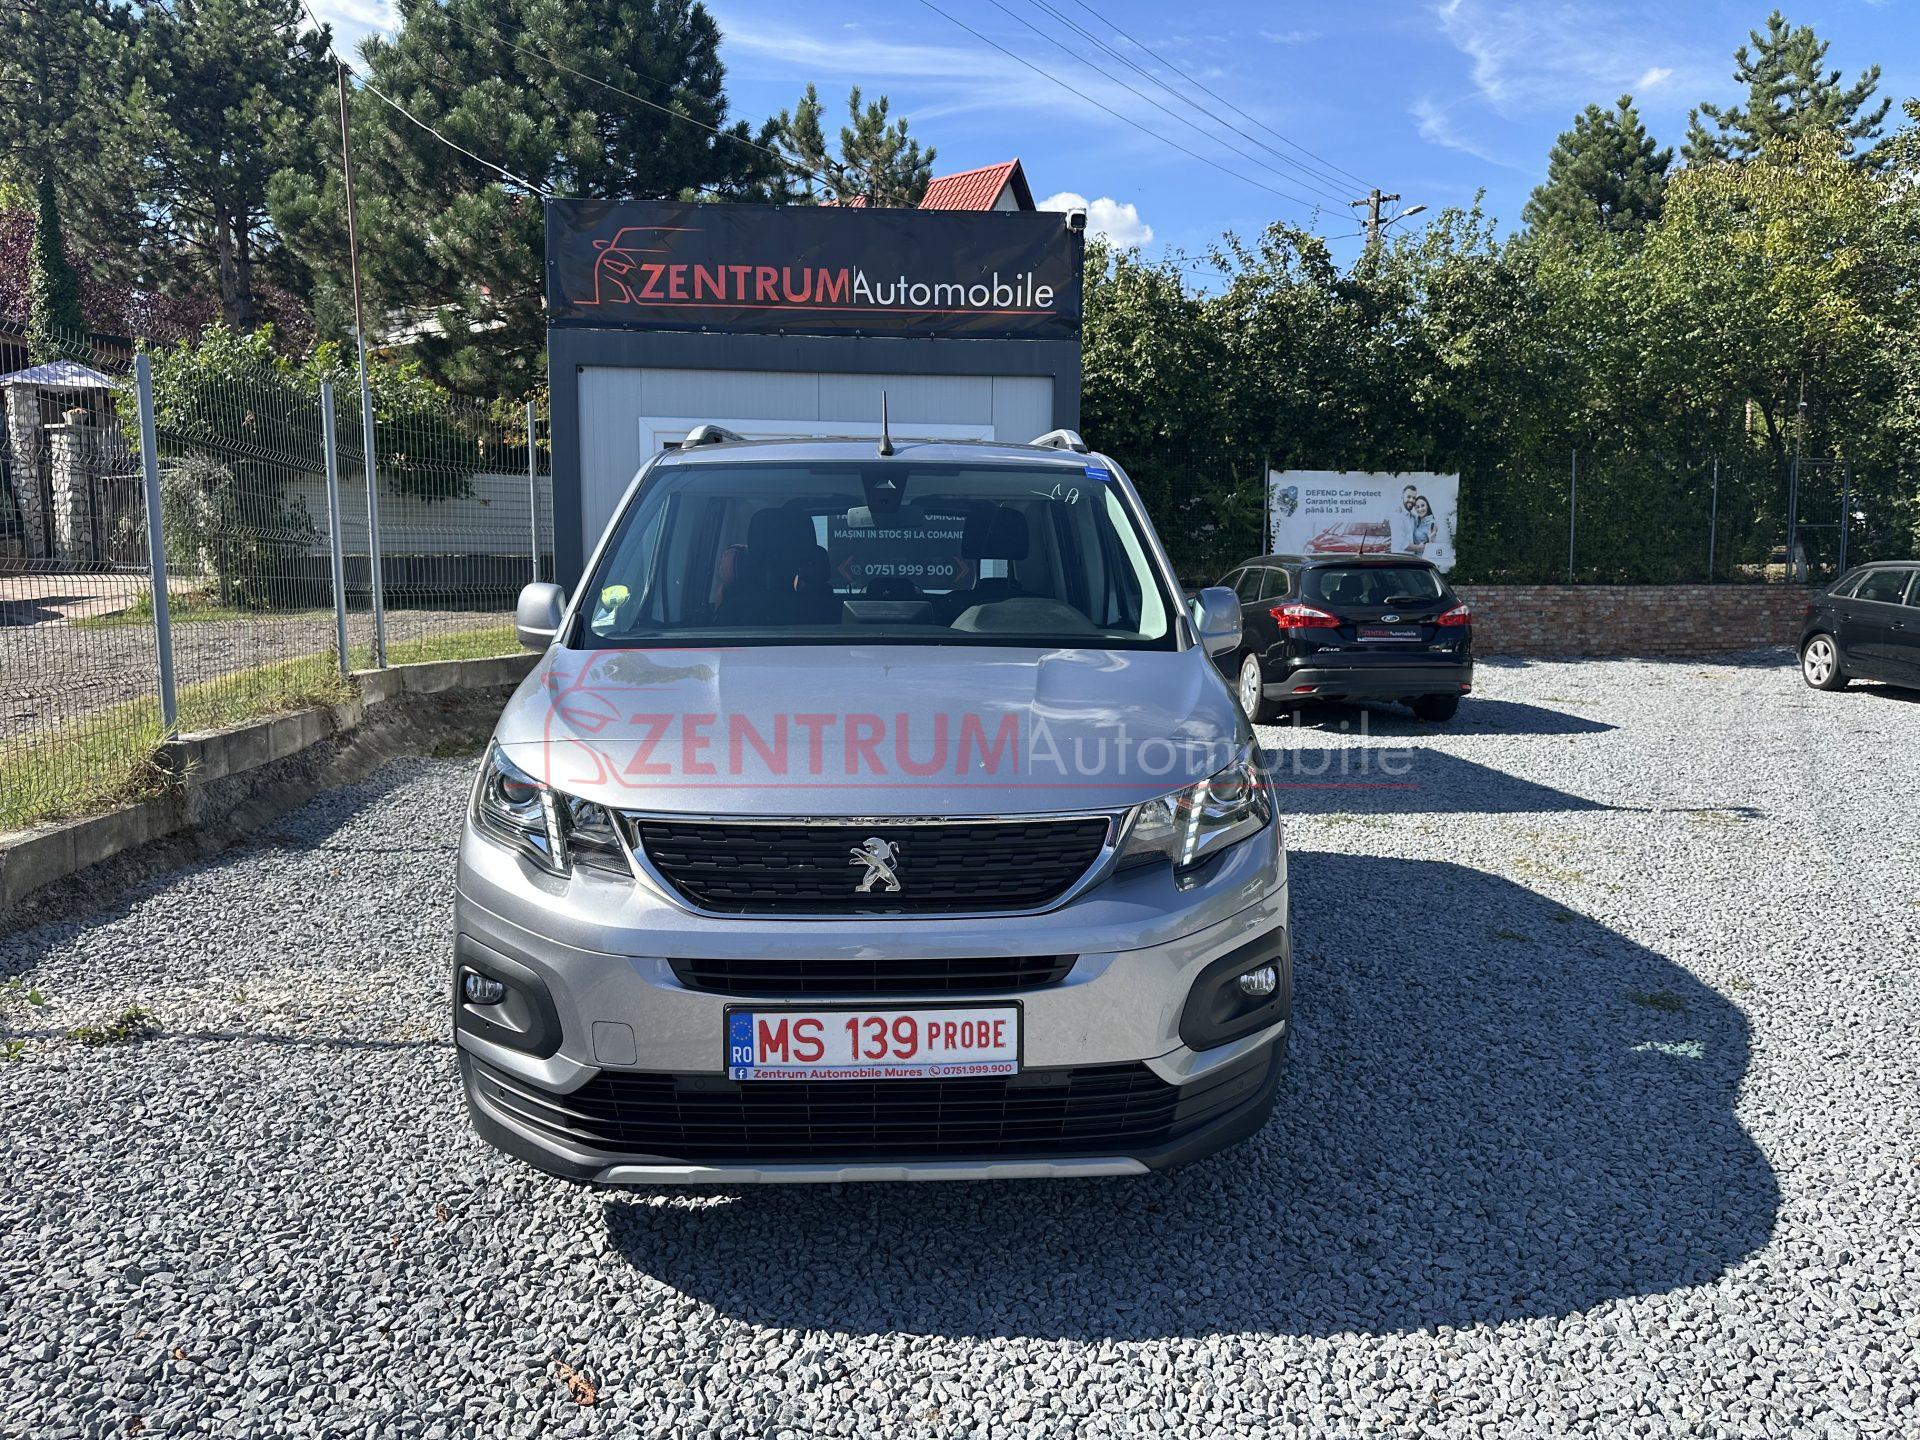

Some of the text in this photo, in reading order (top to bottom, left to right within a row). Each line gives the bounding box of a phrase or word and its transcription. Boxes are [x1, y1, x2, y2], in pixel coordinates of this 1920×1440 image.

[638, 263, 1054, 308] ZENTRUM Automobile
[878, 530, 902, 539] STOC
[914, 530, 925, 539] LA
[865, 564, 954, 576] 0751 999 900
[758, 1016, 1007, 1063] MS 139 PROBE
[732, 1046, 753, 1063] RO
[754, 1064, 1012, 1079] Zentrum Automobile Mures 0751.999.900
